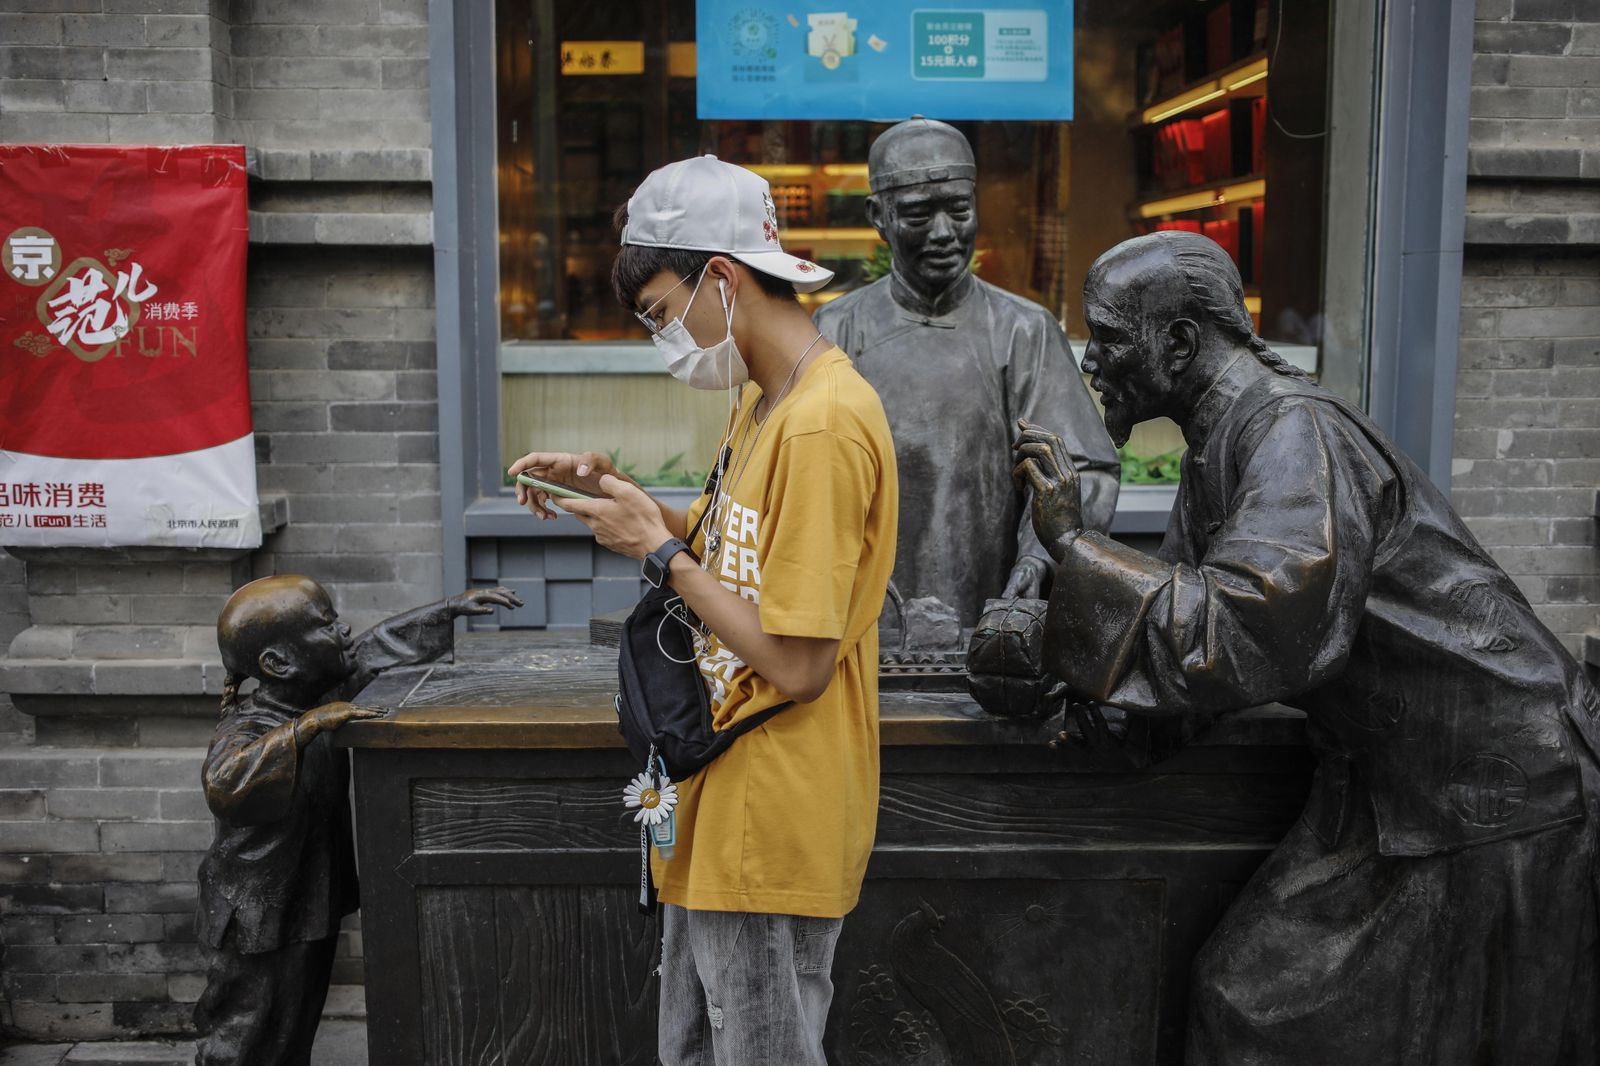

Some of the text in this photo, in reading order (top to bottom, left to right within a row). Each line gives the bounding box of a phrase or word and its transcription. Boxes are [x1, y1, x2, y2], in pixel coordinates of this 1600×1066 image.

[9, 235, 56, 280] 京
[144, 302, 199, 320] 消费季
[167, 519, 239, 529] 北京市人民政府
